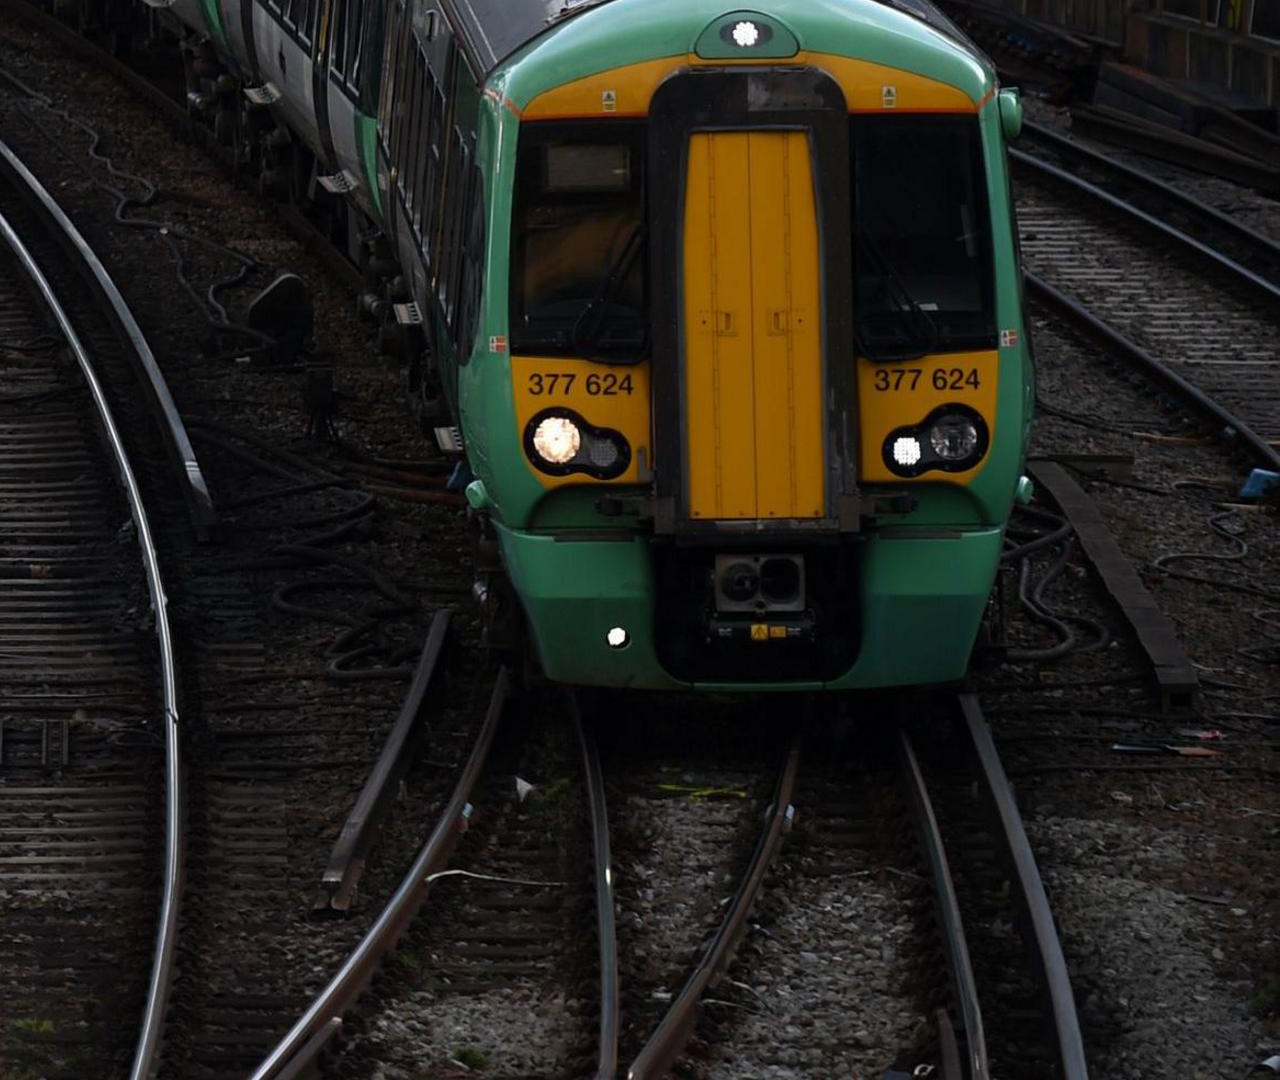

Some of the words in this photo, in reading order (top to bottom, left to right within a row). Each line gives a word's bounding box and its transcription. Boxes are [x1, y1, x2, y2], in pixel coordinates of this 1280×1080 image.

[528, 373, 577, 396] 377
[585, 372, 635, 396] 624
[874, 367, 923, 391] 377
[932, 368, 981, 391] 624
